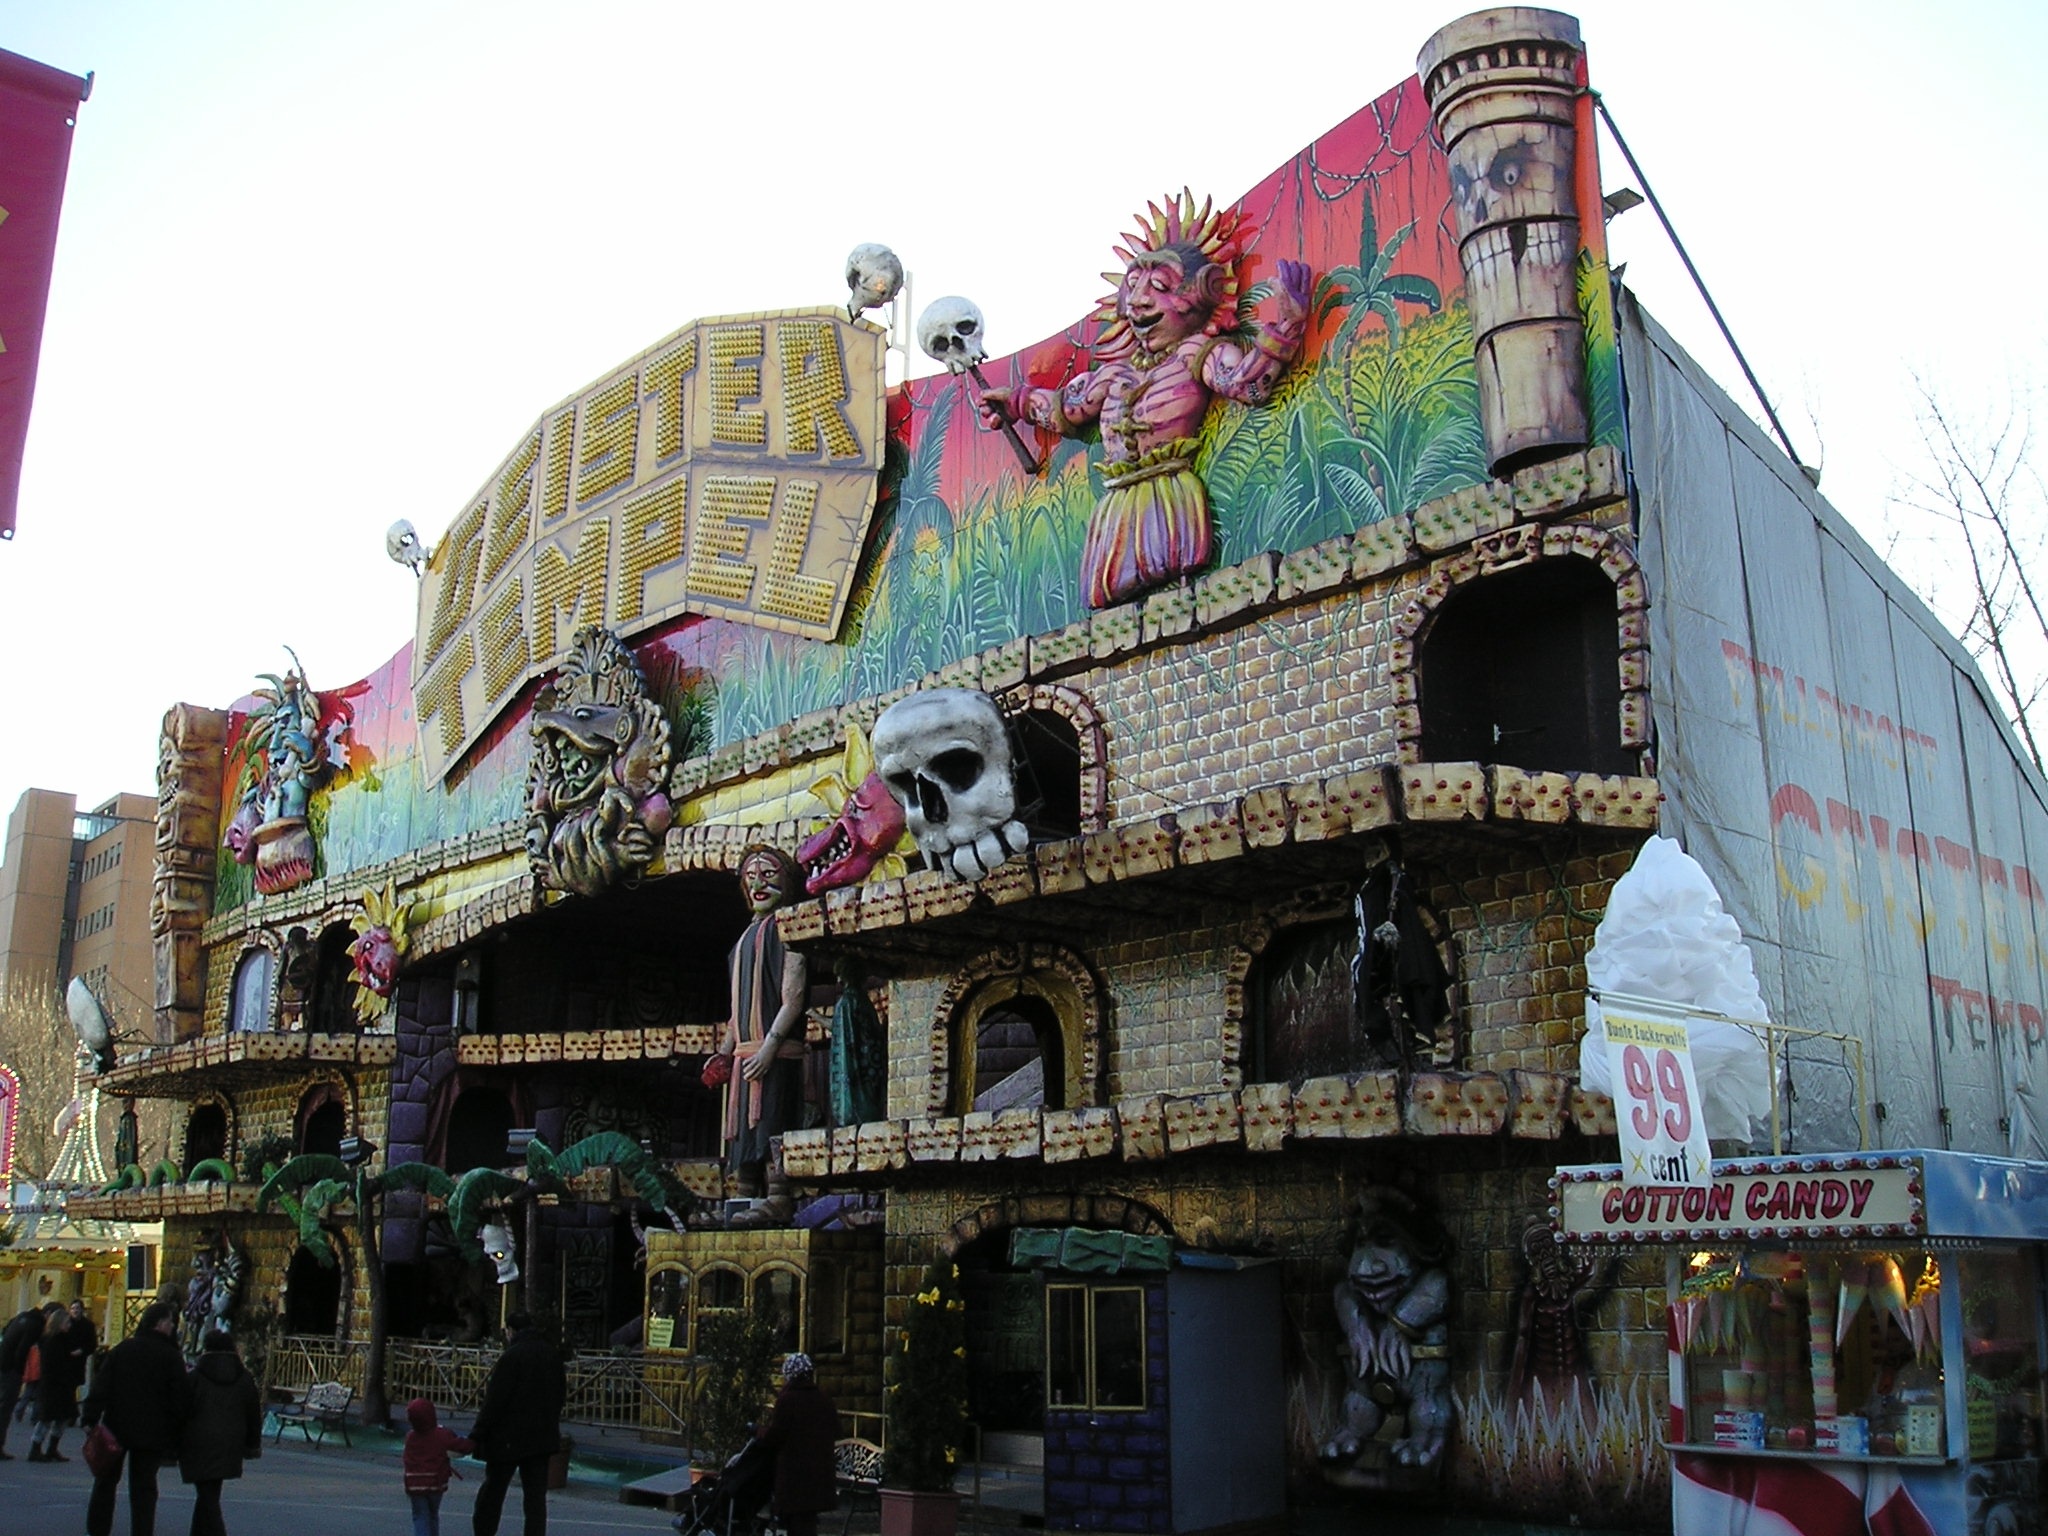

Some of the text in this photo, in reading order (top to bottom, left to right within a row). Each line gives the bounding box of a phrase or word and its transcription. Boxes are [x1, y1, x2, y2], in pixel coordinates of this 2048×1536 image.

[425, 321, 861, 665] GEISTER
[417, 473, 838, 756] TEMPEL
[1929, 974, 2048, 1063] TEMP
[1622, 1044, 1692, 1143] 99
[1602, 1179, 1873, 1224] COTTON CANDY
[1650, 1147, 1690, 1183] cent
